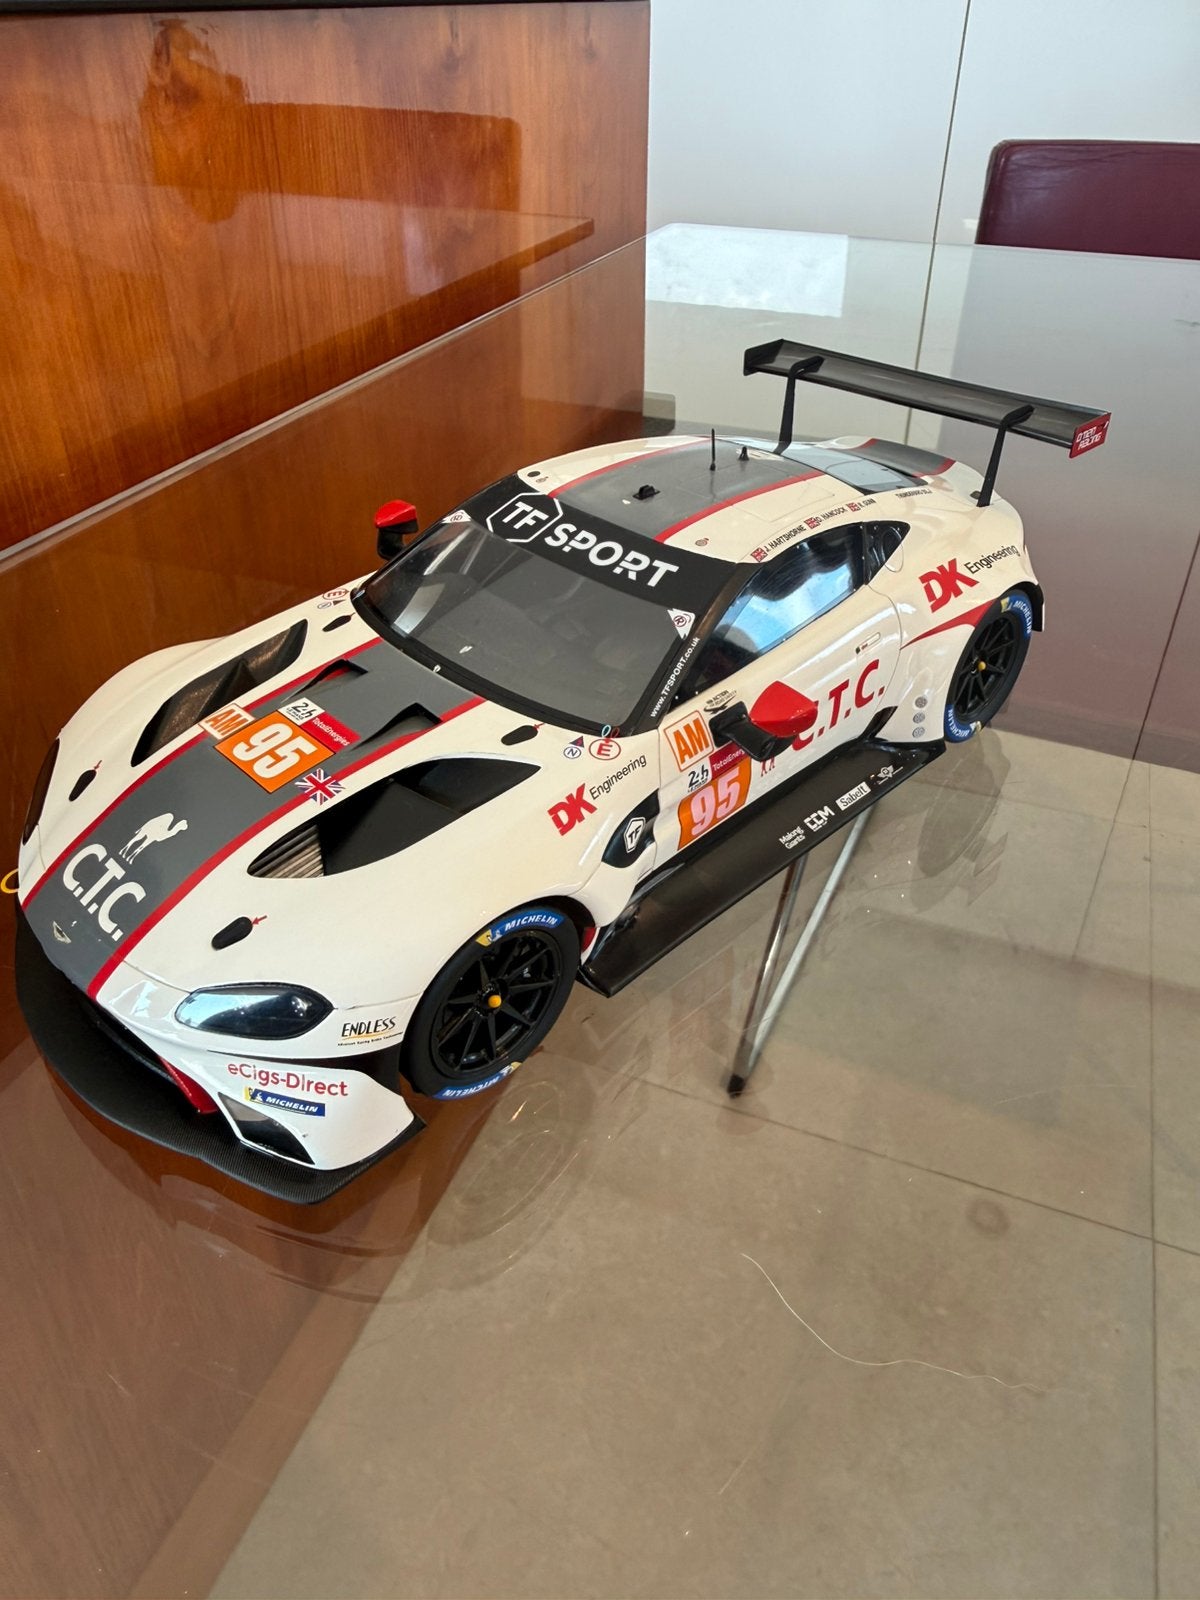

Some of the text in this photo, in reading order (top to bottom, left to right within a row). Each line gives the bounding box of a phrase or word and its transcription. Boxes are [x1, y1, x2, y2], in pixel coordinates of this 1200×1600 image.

[502, 501, 680, 587] TF SPORT
[769, 523, 807, 551] HARTSHORNE
[918, 545, 1021, 613] DK Engineering
[1012, 600, 1032, 634] MICHELIN
[650, 636, 700, 718] www.TFSPORT.co.uk
[205, 708, 249, 737] AM
[312, 717, 350, 746] TotalEnergies
[947, 708, 971, 737] MICHELIN
[232, 722, 318, 780] 95
[597, 743, 613, 757] E
[673, 717, 710, 764] AM
[547, 754, 647, 836] DK Engineering
[690, 766, 741, 836] 95
[839, 784, 868, 808] Sabelt
[628, 824, 642, 844] TF
[63, 843, 147, 942] C.T.C.
[504, 914, 559, 932] MICHELIN
[341, 1015, 397, 1038] ENDLESS
[442, 1075, 500, 1097] MICHELIN
[265, 1096, 320, 1113] MICHELIN
